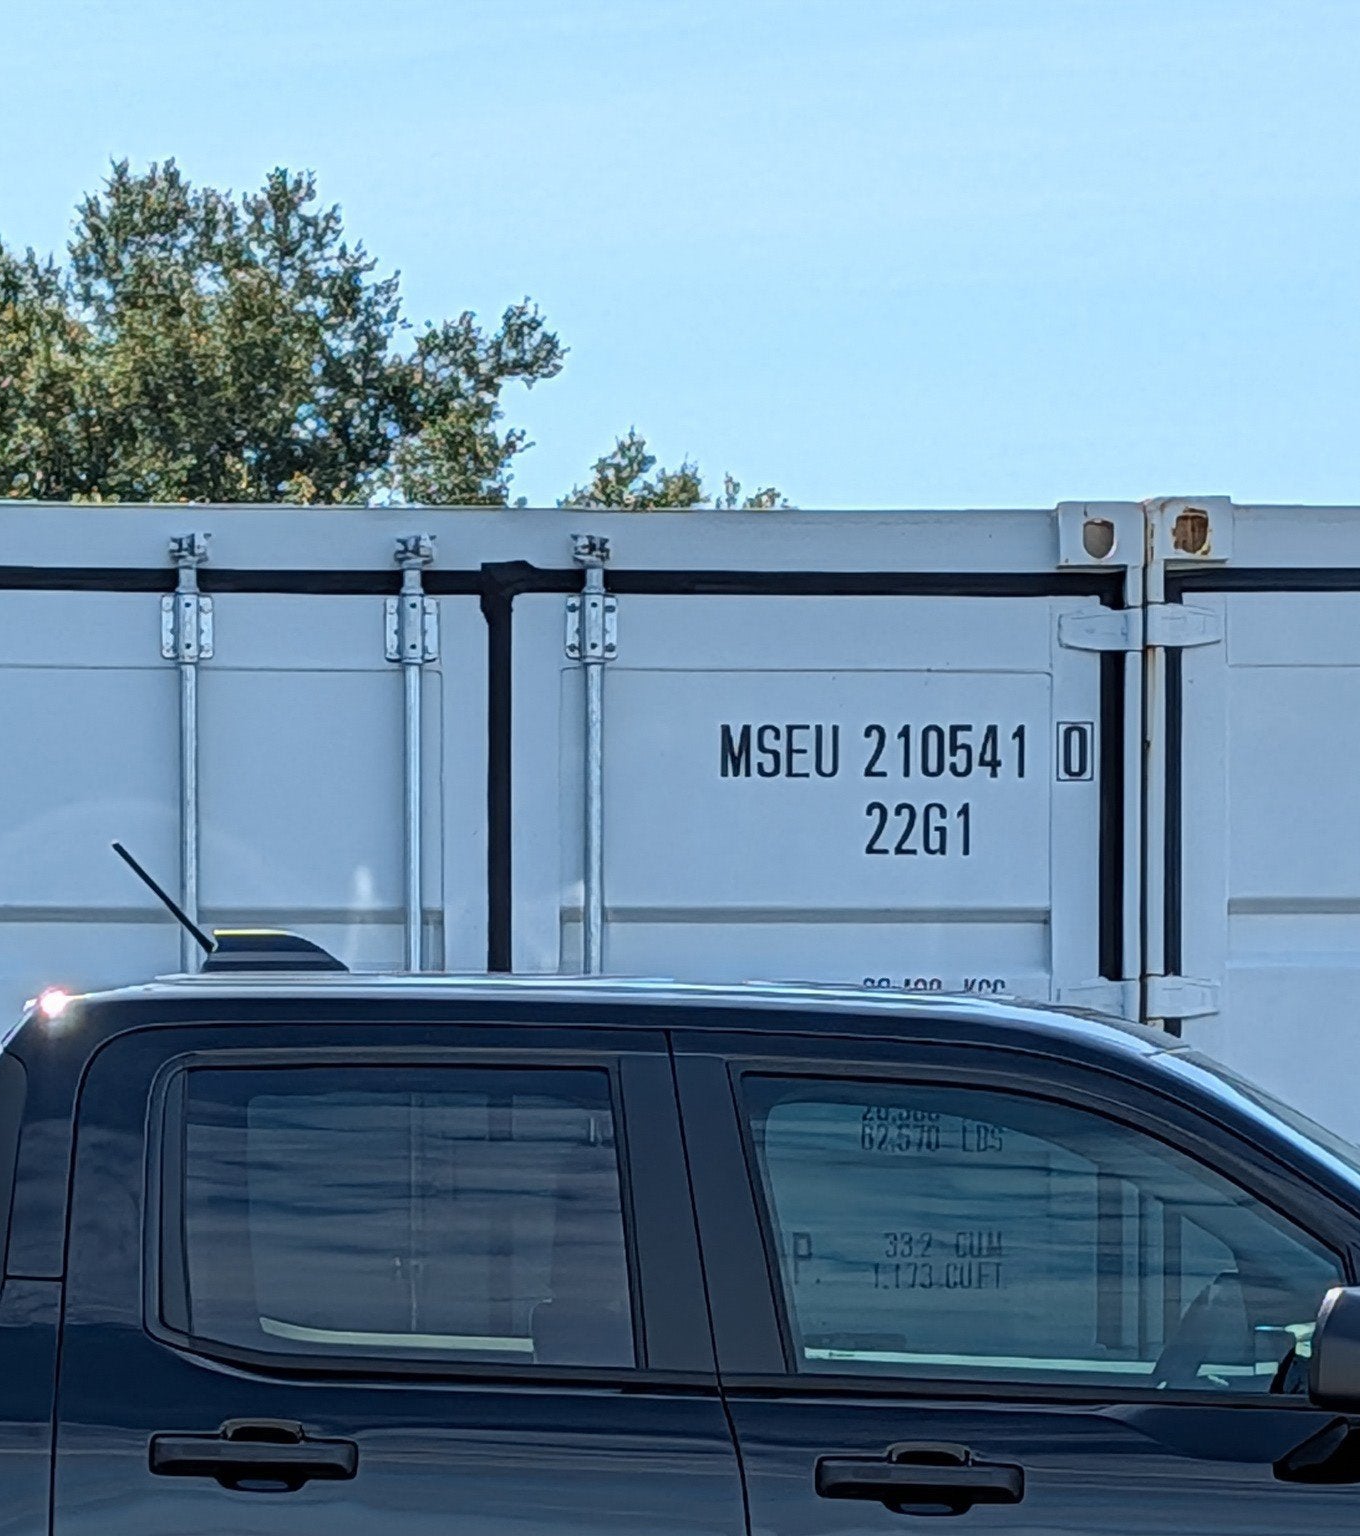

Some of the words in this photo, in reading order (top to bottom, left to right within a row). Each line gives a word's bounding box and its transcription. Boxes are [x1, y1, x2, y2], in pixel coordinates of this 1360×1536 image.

[720, 724, 840, 778] MSEU
[863, 724, 1026, 778] 210541
[1063, 725, 1088, 777] 0
[865, 801, 971, 856] 22G1
